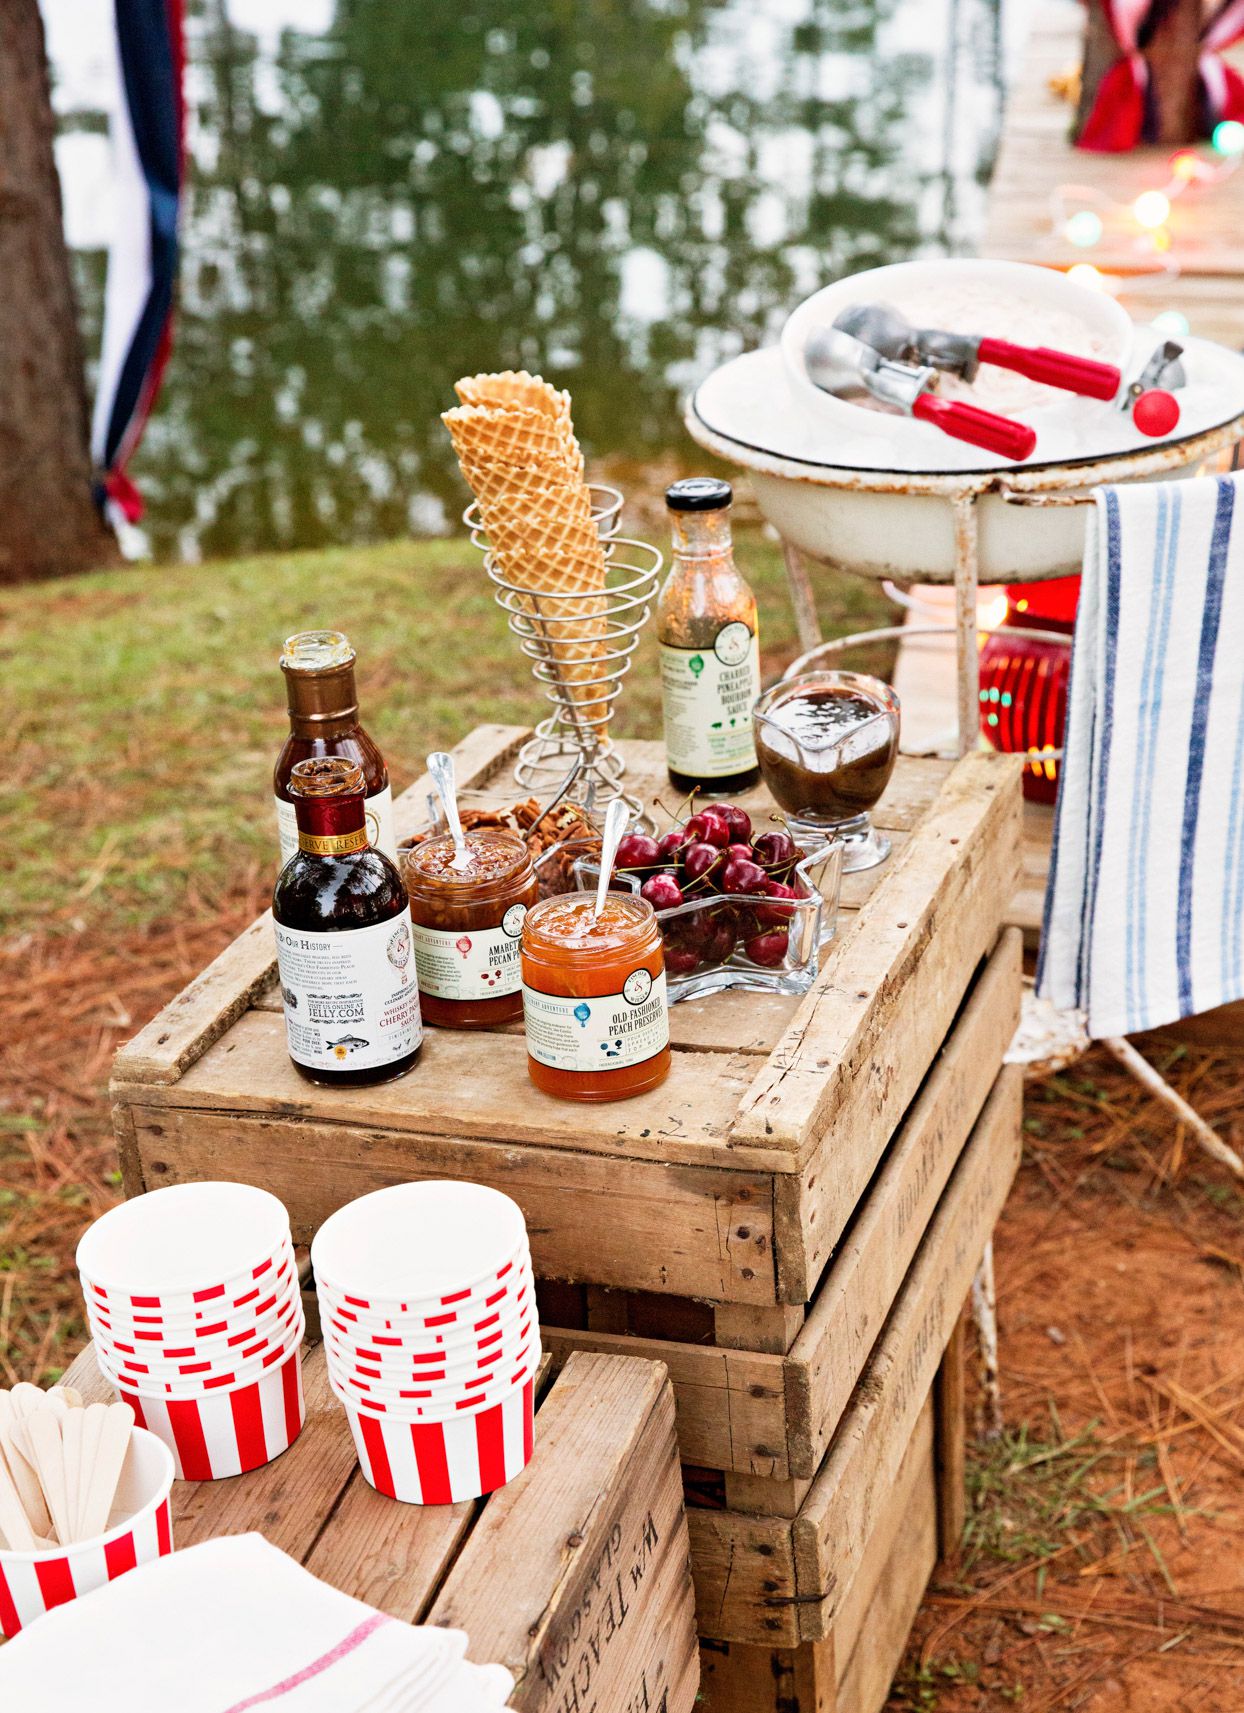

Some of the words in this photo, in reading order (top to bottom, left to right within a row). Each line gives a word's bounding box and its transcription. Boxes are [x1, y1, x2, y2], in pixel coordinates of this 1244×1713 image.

[717, 675, 753, 694] PINEAPPLE
[721, 688, 751, 705] BOURBON
[727, 701, 748, 715] SAUCE
[489, 951, 512, 966] PECAN
[309, 1008, 365, 1018] JELLY.COM
[379, 1010, 408, 1028] CHERRY
[400, 1014, 415, 1028] SAUCE
[609, 1019, 633, 1036] PEACH
[634, 1006, 663, 1029] PRESERVES
